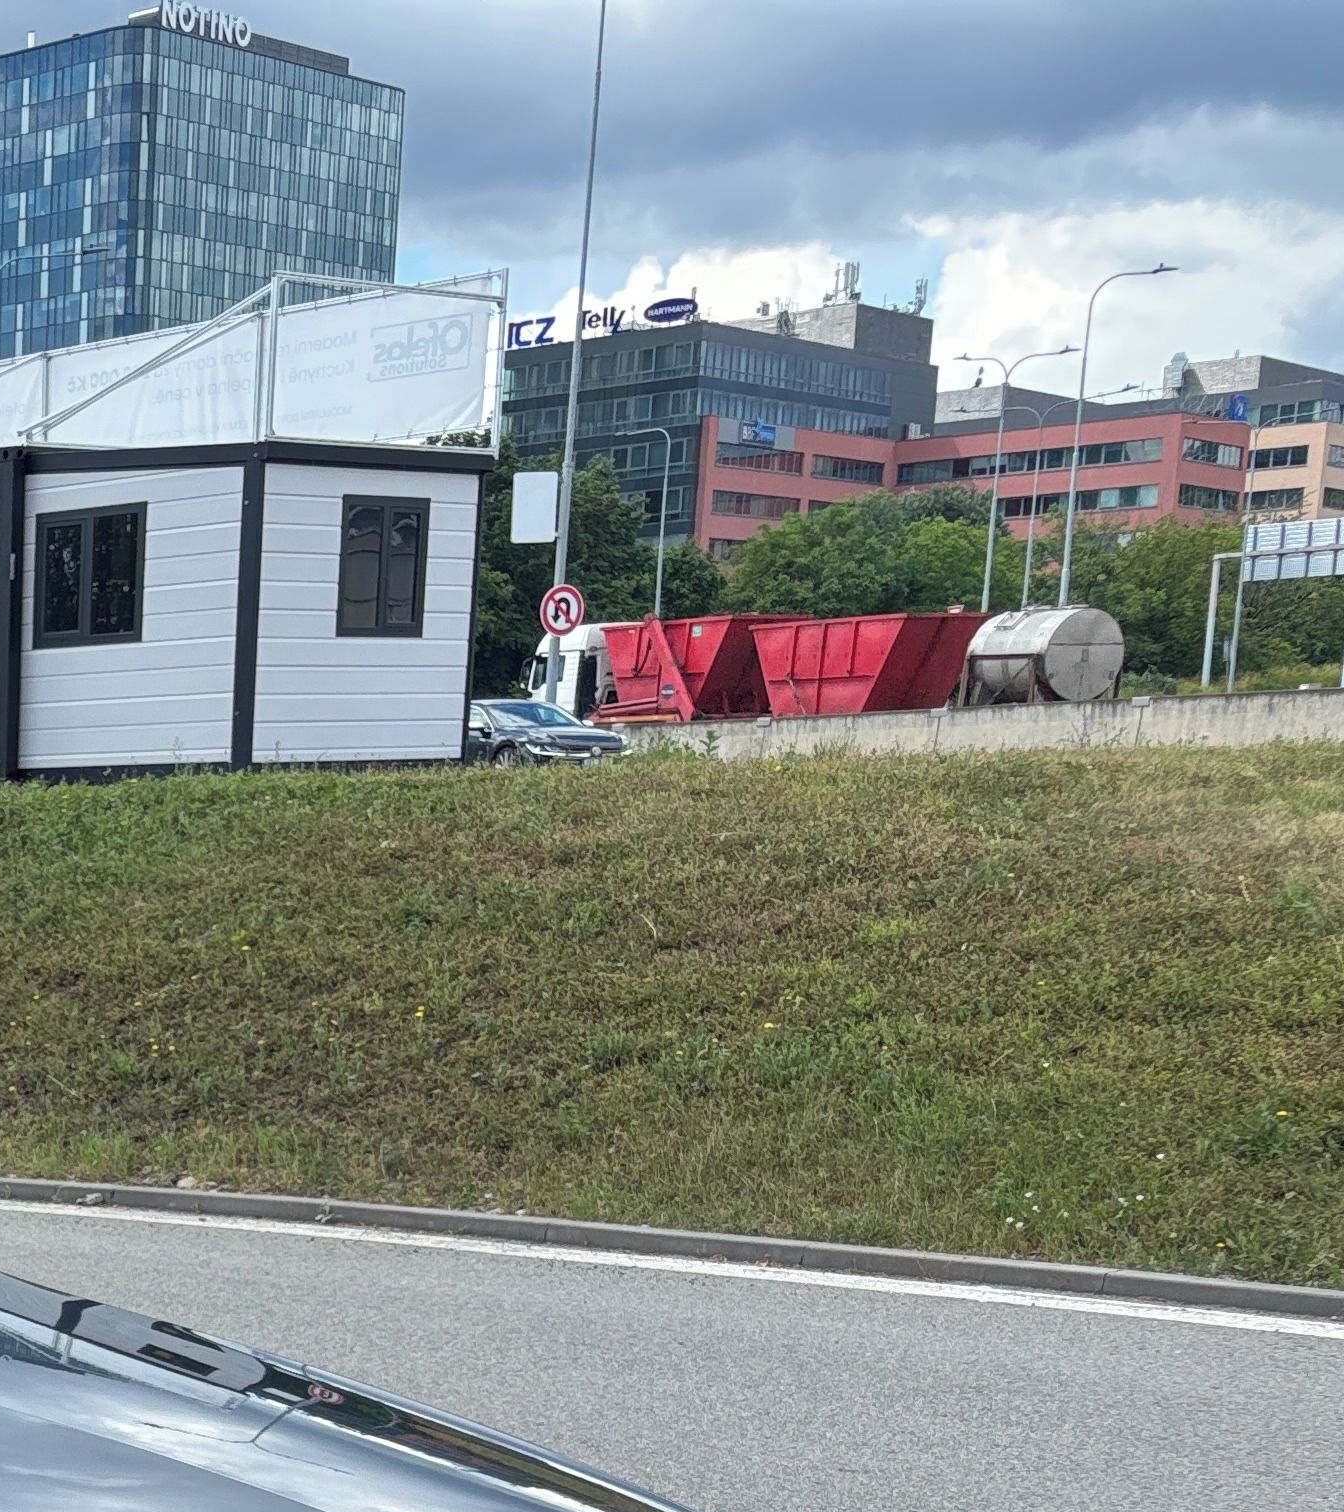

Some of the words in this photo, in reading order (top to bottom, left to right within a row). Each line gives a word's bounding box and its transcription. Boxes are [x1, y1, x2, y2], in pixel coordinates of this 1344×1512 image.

[161, 0, 252, 48] NOTINO
[582, 306, 626, 335] Telly
[647, 303, 694, 318] HARTMANN
[507, 317, 556, 349] ICZ
